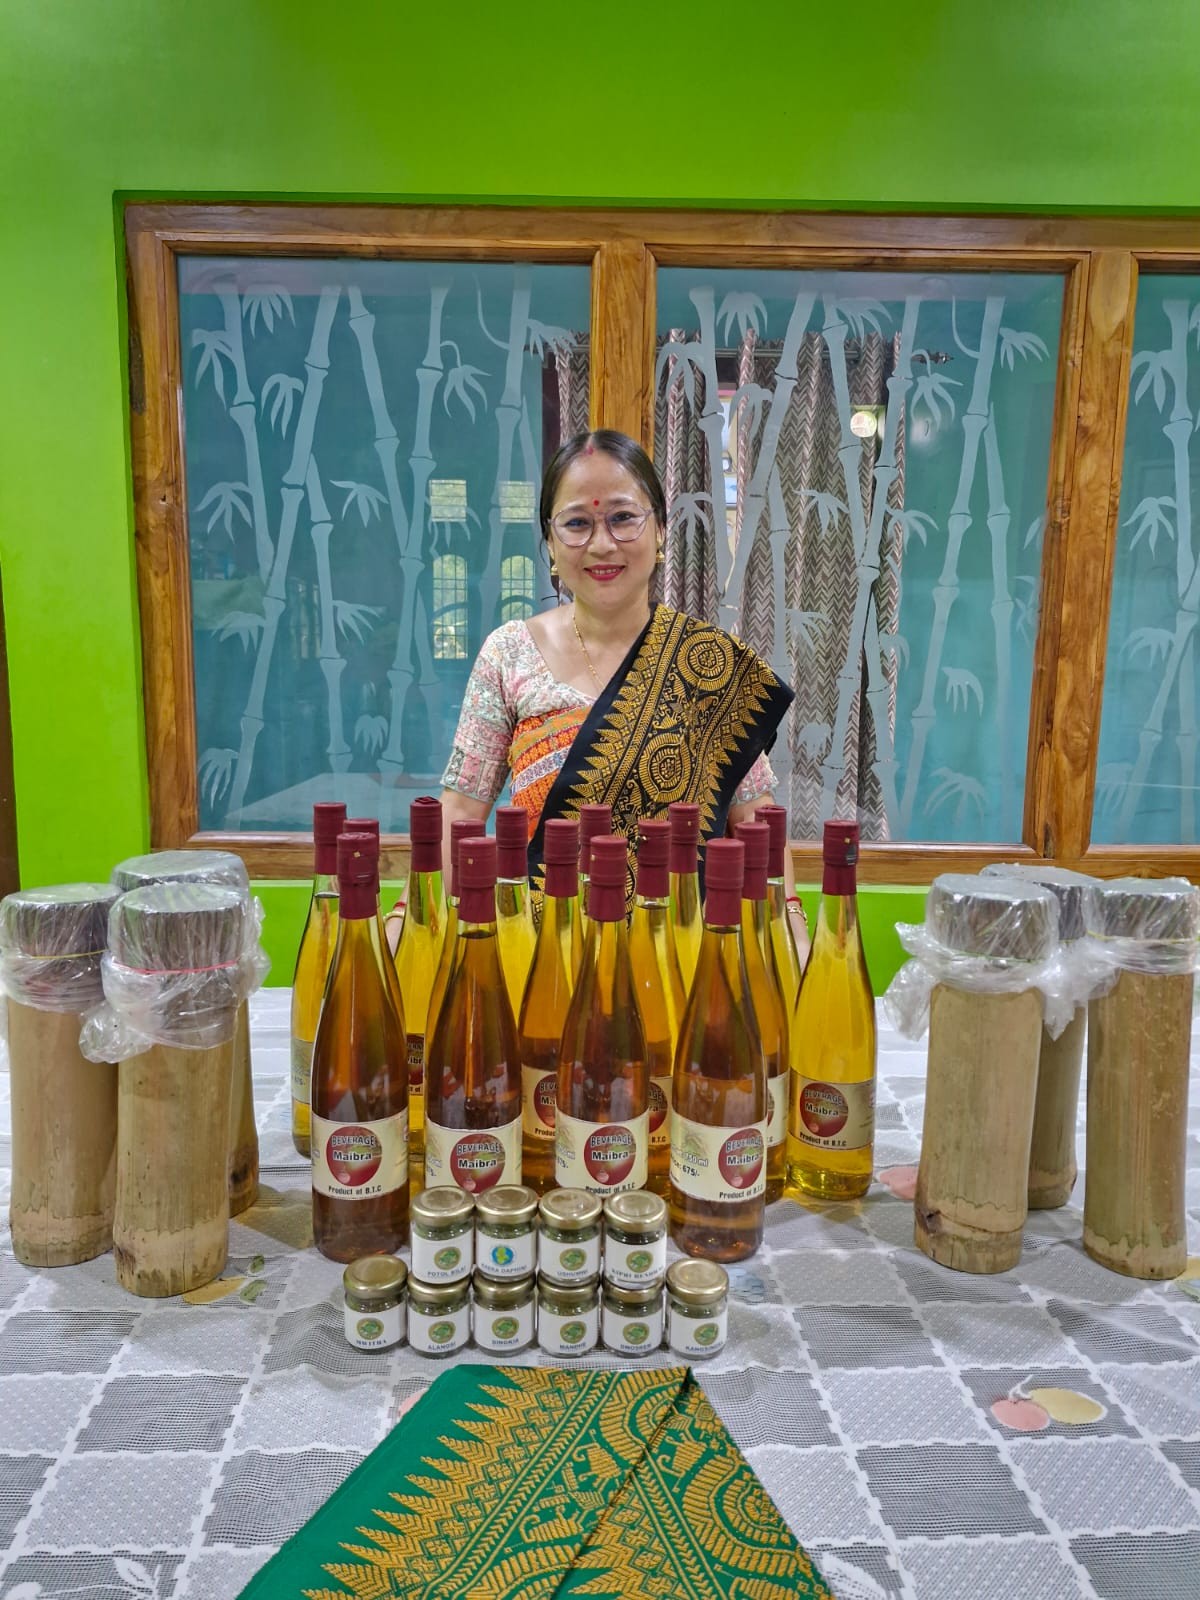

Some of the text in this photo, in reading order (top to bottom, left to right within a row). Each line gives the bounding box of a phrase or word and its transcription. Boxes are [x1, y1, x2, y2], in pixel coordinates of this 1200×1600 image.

[804, 1089, 843, 1105] BEVERAGE
[805, 1103, 839, 1116] Maibra
[331, 1135, 376, 1147] BEVERAGE
[591, 1134, 632, 1147] BEVERAGE
[726, 1135, 762, 1152] BEVERAGE
[800, 1132, 821, 1144] Product
[457, 1143, 501, 1155] BEVERAGE
[333, 1150, 373, 1161] Maibra
[592, 1151, 629, 1161] Maibra
[727, 1153, 760, 1166] Maibra
[458, 1158, 497, 1168] Maibra
[328, 1185, 353, 1195] Product
[586, 1185, 611, 1194] Product
[719, 1191, 745, 1199] Product
